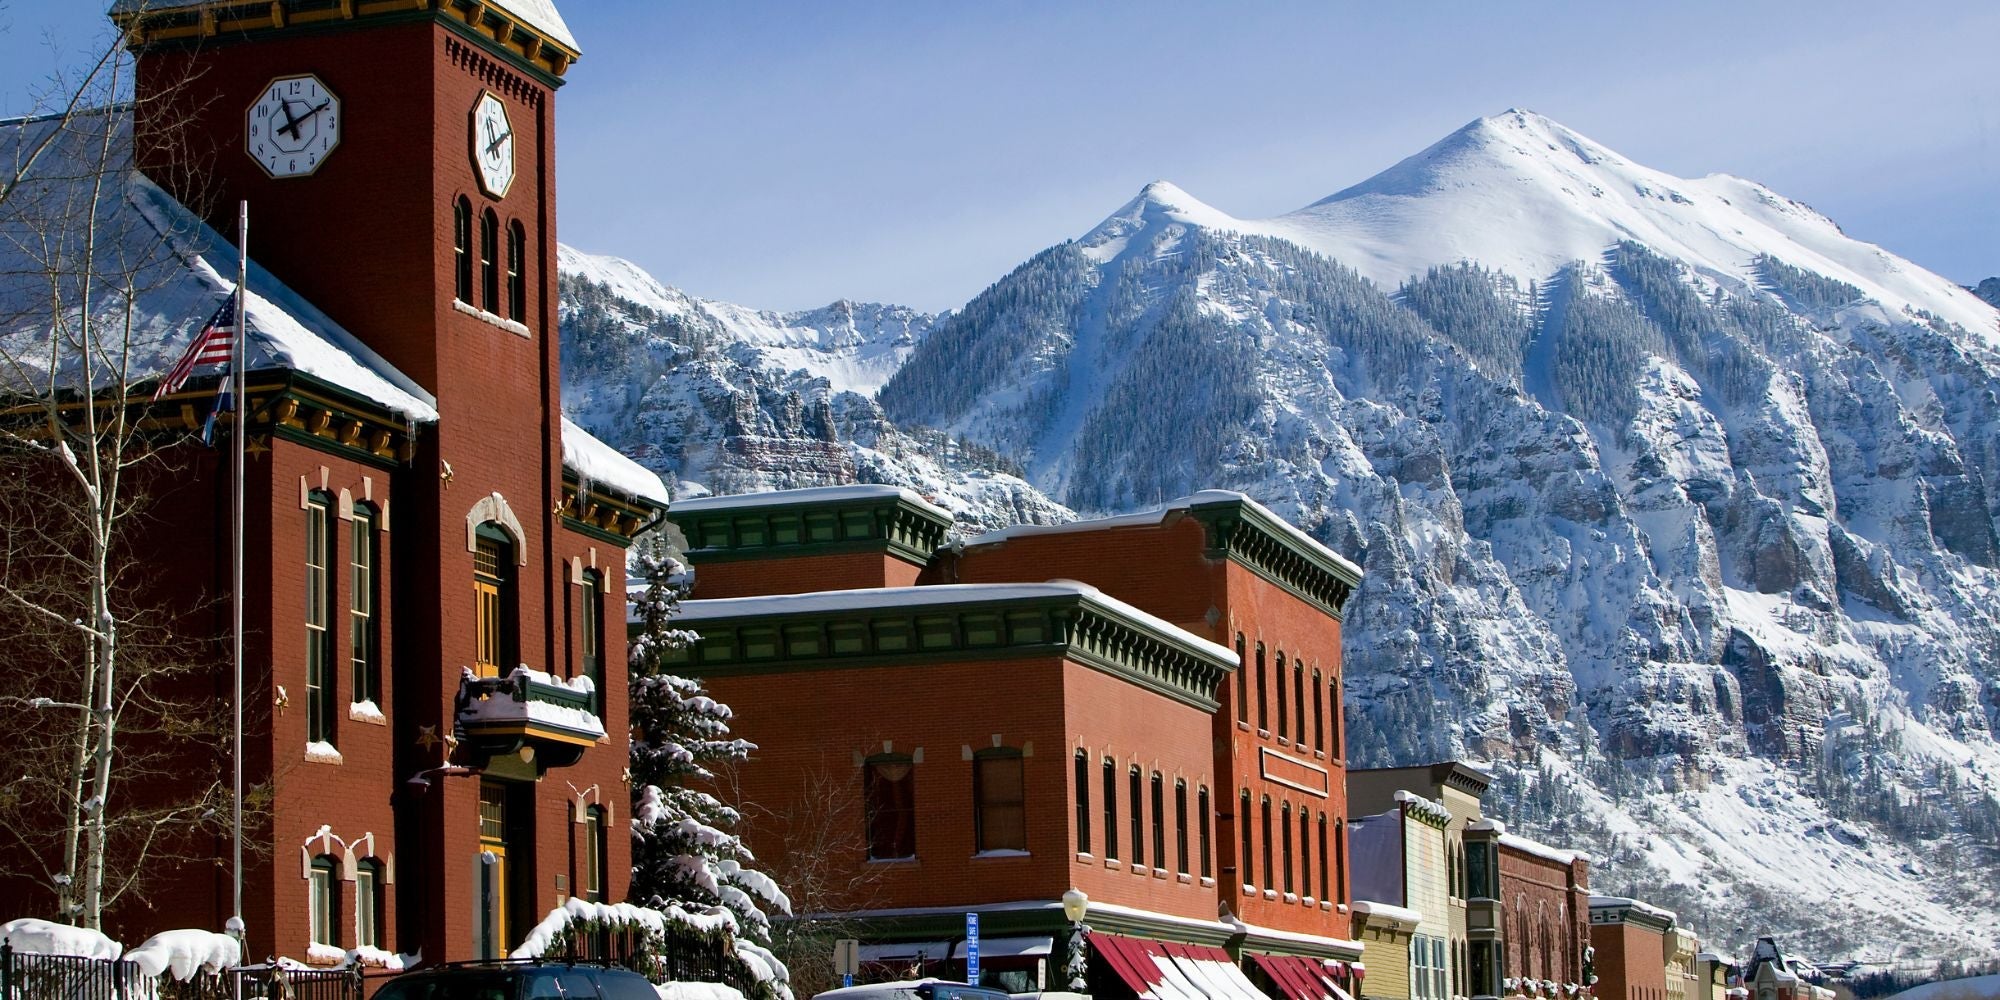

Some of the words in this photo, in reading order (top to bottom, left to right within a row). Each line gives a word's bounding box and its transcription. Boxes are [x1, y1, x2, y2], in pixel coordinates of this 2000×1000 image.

[272, 88, 281, 101] 11
[289, 81, 301, 95] 12
[312, 84, 315, 97] 1
[257, 104, 268, 118] 10
[329, 116, 335, 129] 3
[252, 125, 258, 137] 9
[257, 143, 264, 157] 8
[321, 137, 327, 151] 4
[271, 156, 277, 170] 7
[289, 159, 295, 172] 6
[309, 153, 315, 165] 5
